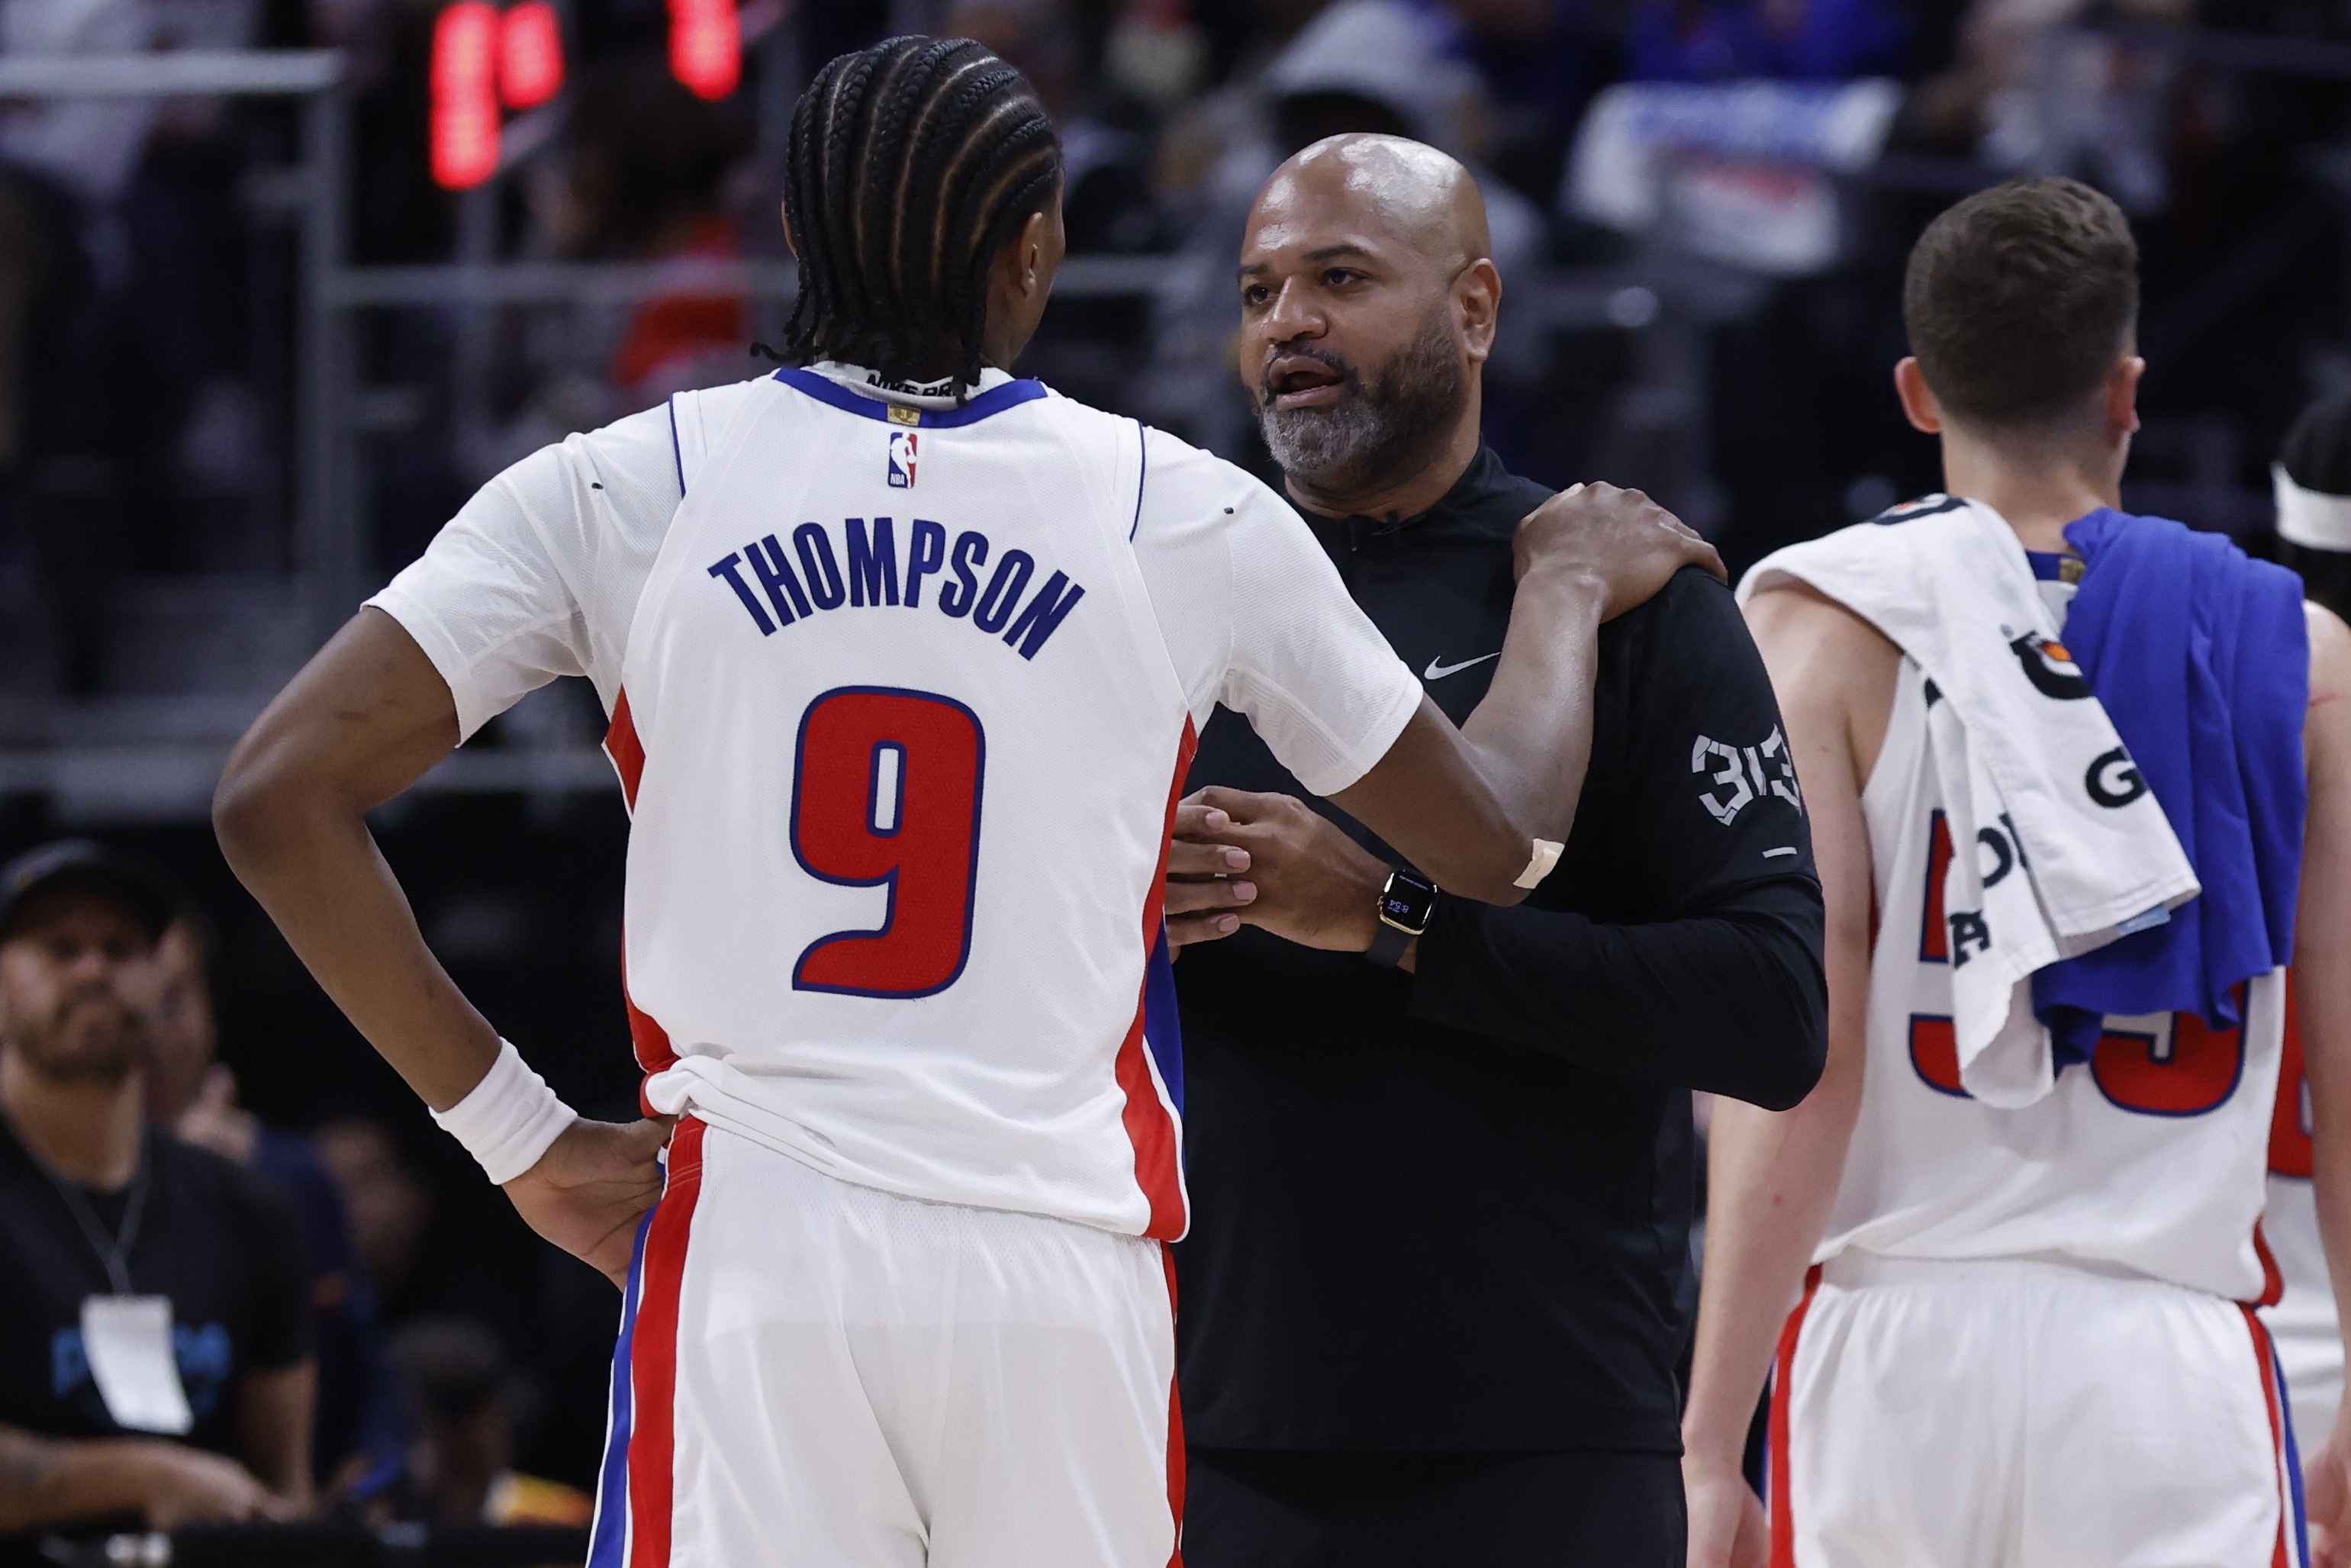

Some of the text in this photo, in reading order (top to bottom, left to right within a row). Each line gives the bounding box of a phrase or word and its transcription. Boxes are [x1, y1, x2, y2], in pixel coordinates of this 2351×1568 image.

[890, 473, 905, 485] NBA
[707, 517, 1086, 662] THOMPSON
[1691, 723, 1802, 826] 313
[789, 685, 986, 1000] 9
